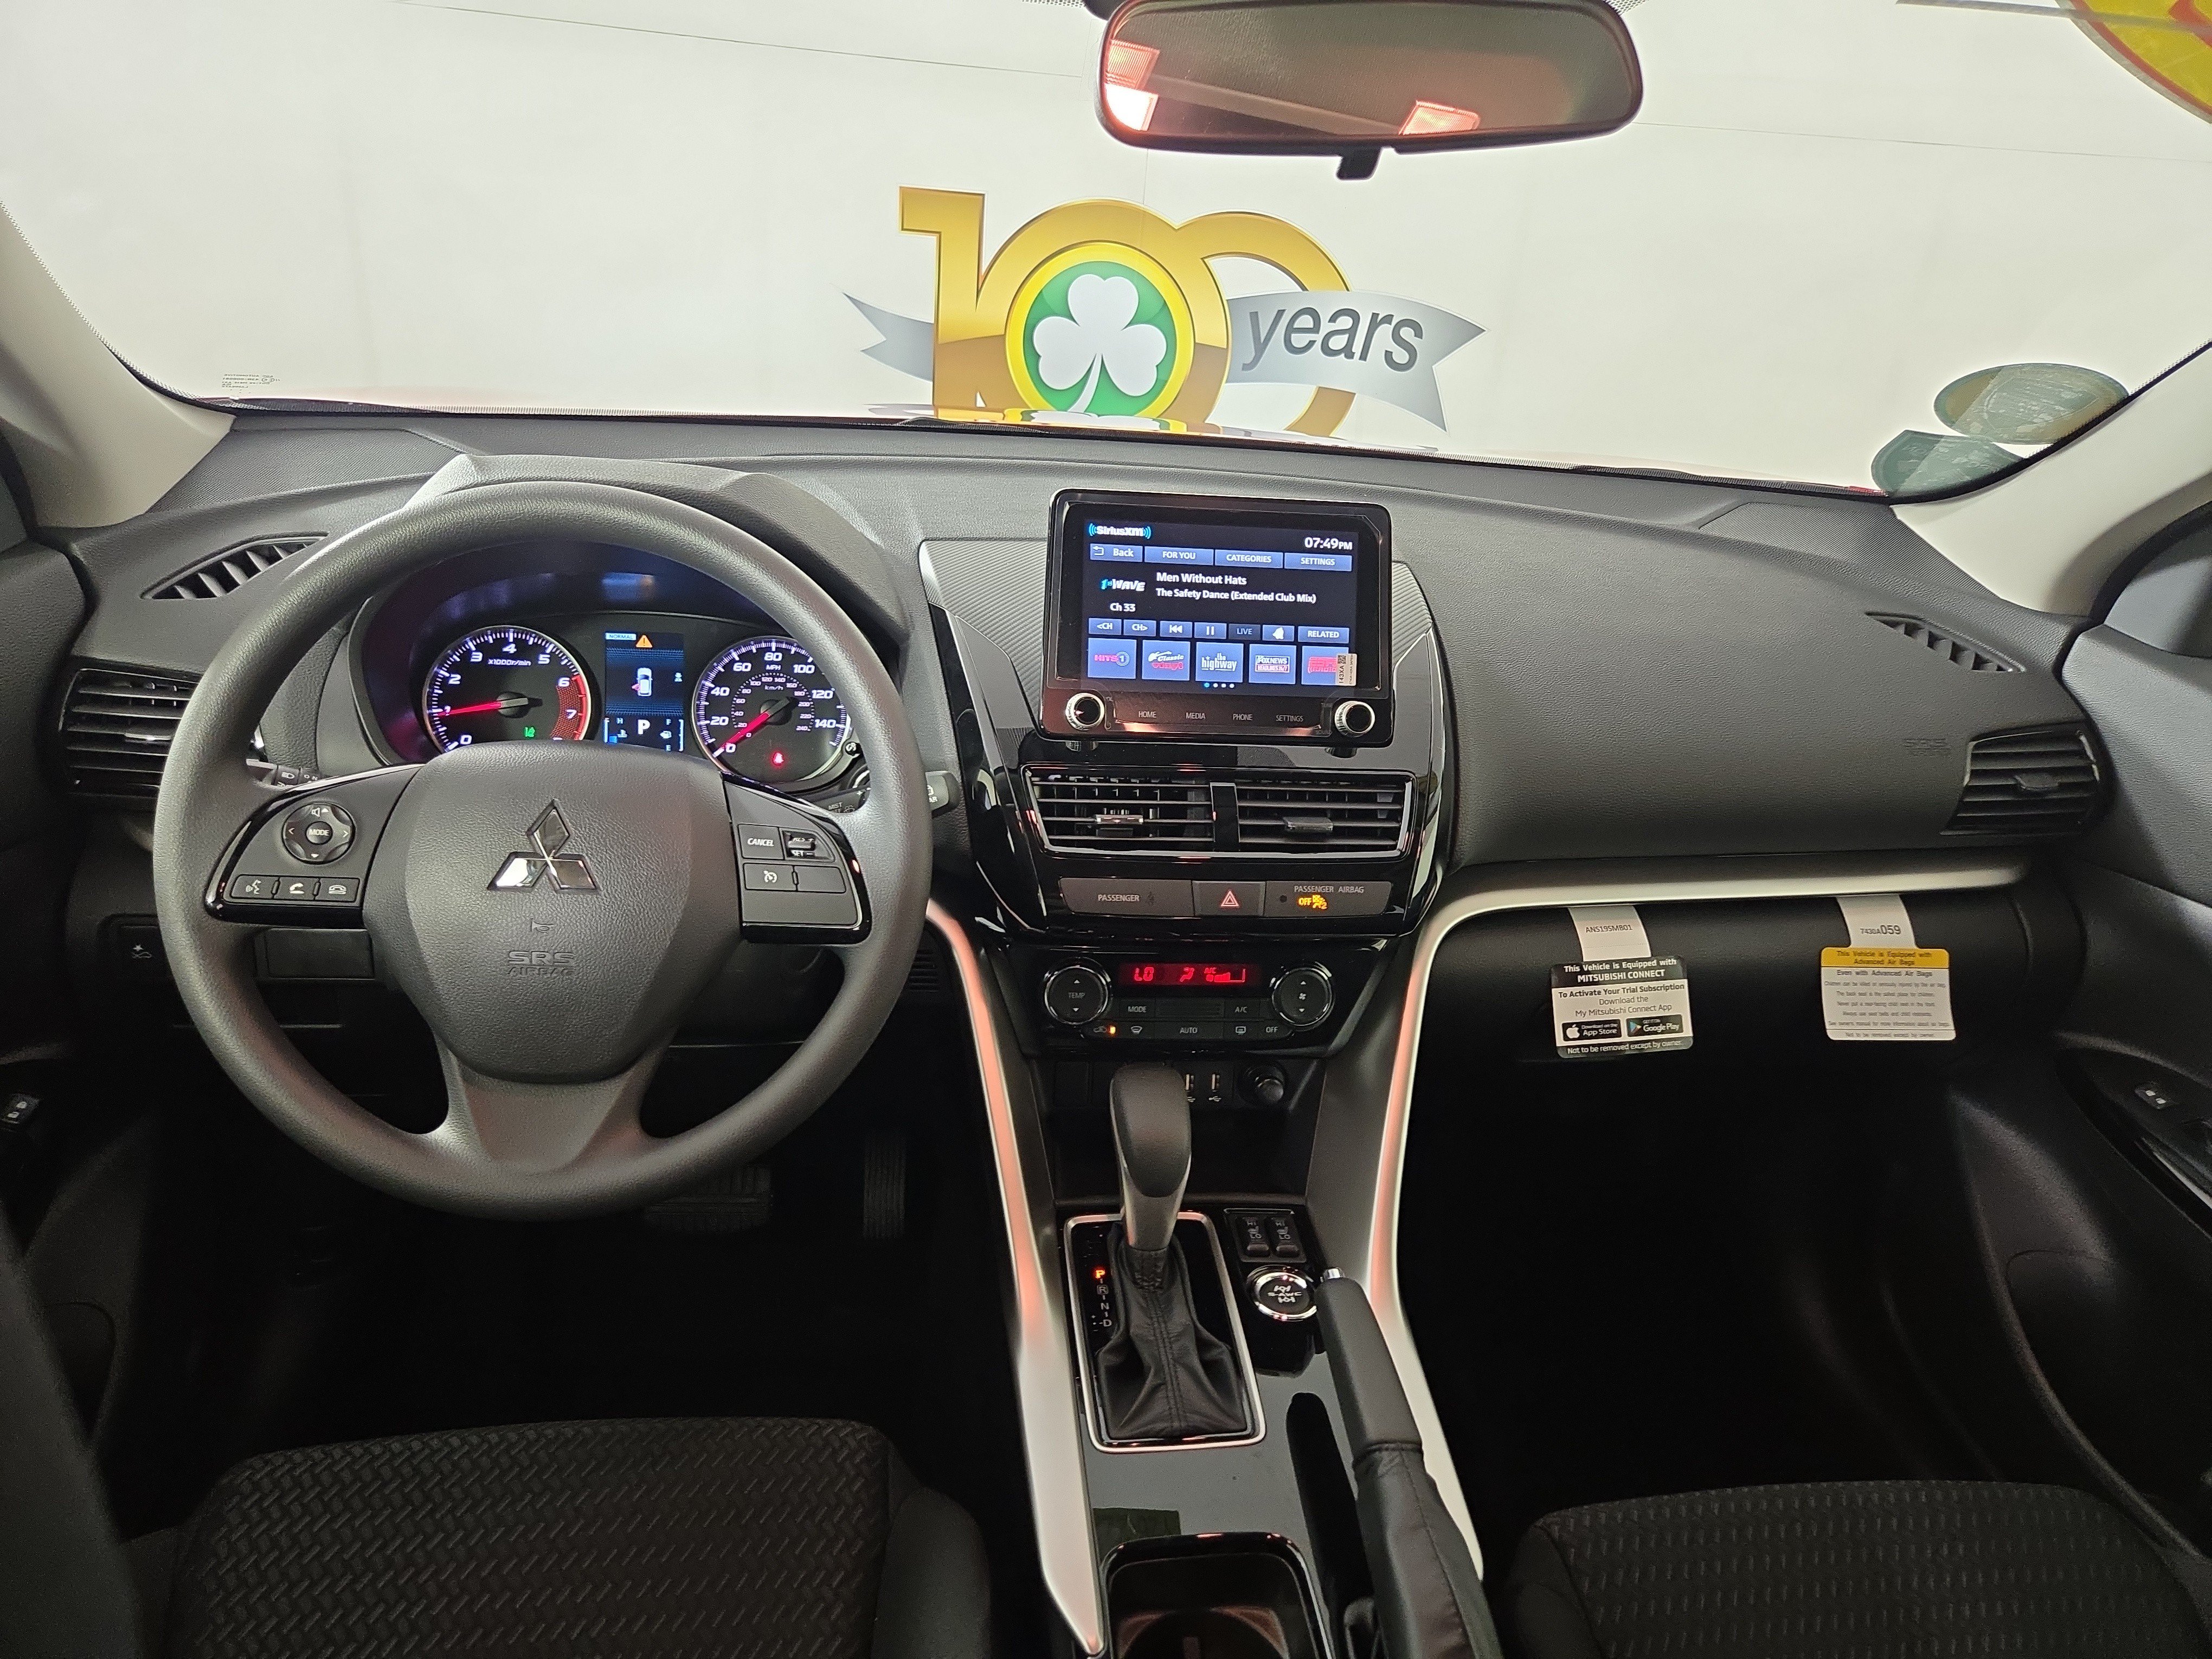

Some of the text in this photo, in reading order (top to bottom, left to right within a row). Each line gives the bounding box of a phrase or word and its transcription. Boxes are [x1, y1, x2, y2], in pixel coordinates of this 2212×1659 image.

[900, 187, 1355, 436] 100
[1241, 304, 1423, 374] years
[1113, 548, 1134, 557] Back
[1179, 551, 1196, 560] YOU
[1226, 554, 1272, 563] CATEGORIES
[1301, 557, 1335, 565] SETTINGS
[1156, 572, 1247, 585] Men Without Hats
[1156, 588, 1317, 604] The Safety Dance (Extended Club Mix)
[1110, 602, 1136, 612] Ch 33
[1308, 630, 1340, 639] RELATED
[503, 644, 517, 654] 4
[470, 651, 483, 662] 3
[538, 654, 551, 665] 5
[764, 652, 782, 661] 80
[1217, 652, 1226, 660] the
[733, 663, 751, 672] 60
[793, 664, 815, 674] 100
[1201, 656, 1237, 672] highway
[448, 674, 461, 684] 2
[558, 677, 570, 687] 6
[711, 687, 730, 696] 40
[812, 690, 834, 699] 120
[566, 709, 577, 719] 7
[710, 716, 729, 725] 20
[815, 719, 836, 728] 140
[638, 719, 651, 735] P
[460, 735, 472, 744] 0
[725, 743, 736, 753] 0
[748, 838, 774, 846] CANCEL
[1097, 894, 1140, 902] PASSENGER
[1298, 897, 1312, 906] OFF
[1585, 924, 1633, 933] ANS19SMB01
[507, 950, 574, 966] SRS
[1583, 963, 1610, 971] Vehicle
[1622, 960, 1657, 969] Equipped
[507, 967, 573, 976] AIRBAG
[1134, 966, 1154, 981] LO
[1578, 969, 1666, 983] MITSUBISHI CONNECT
[1639, 983, 1684, 992] Subscription
[1599, 996, 1635, 1005] Download
[1589, 1007, 1626, 1016] Mitsubishi
[1628, 1005, 1657, 1013] Connect
[1658, 1004, 1672, 1012] App
[1643, 1023, 1680, 1033] Google Play
[1600, 1043, 1629, 1052] removed
[1630, 1041, 1652, 1050] except
[1095, 1269, 1105, 1279] P
[1103, 1319, 1112, 1327] D
